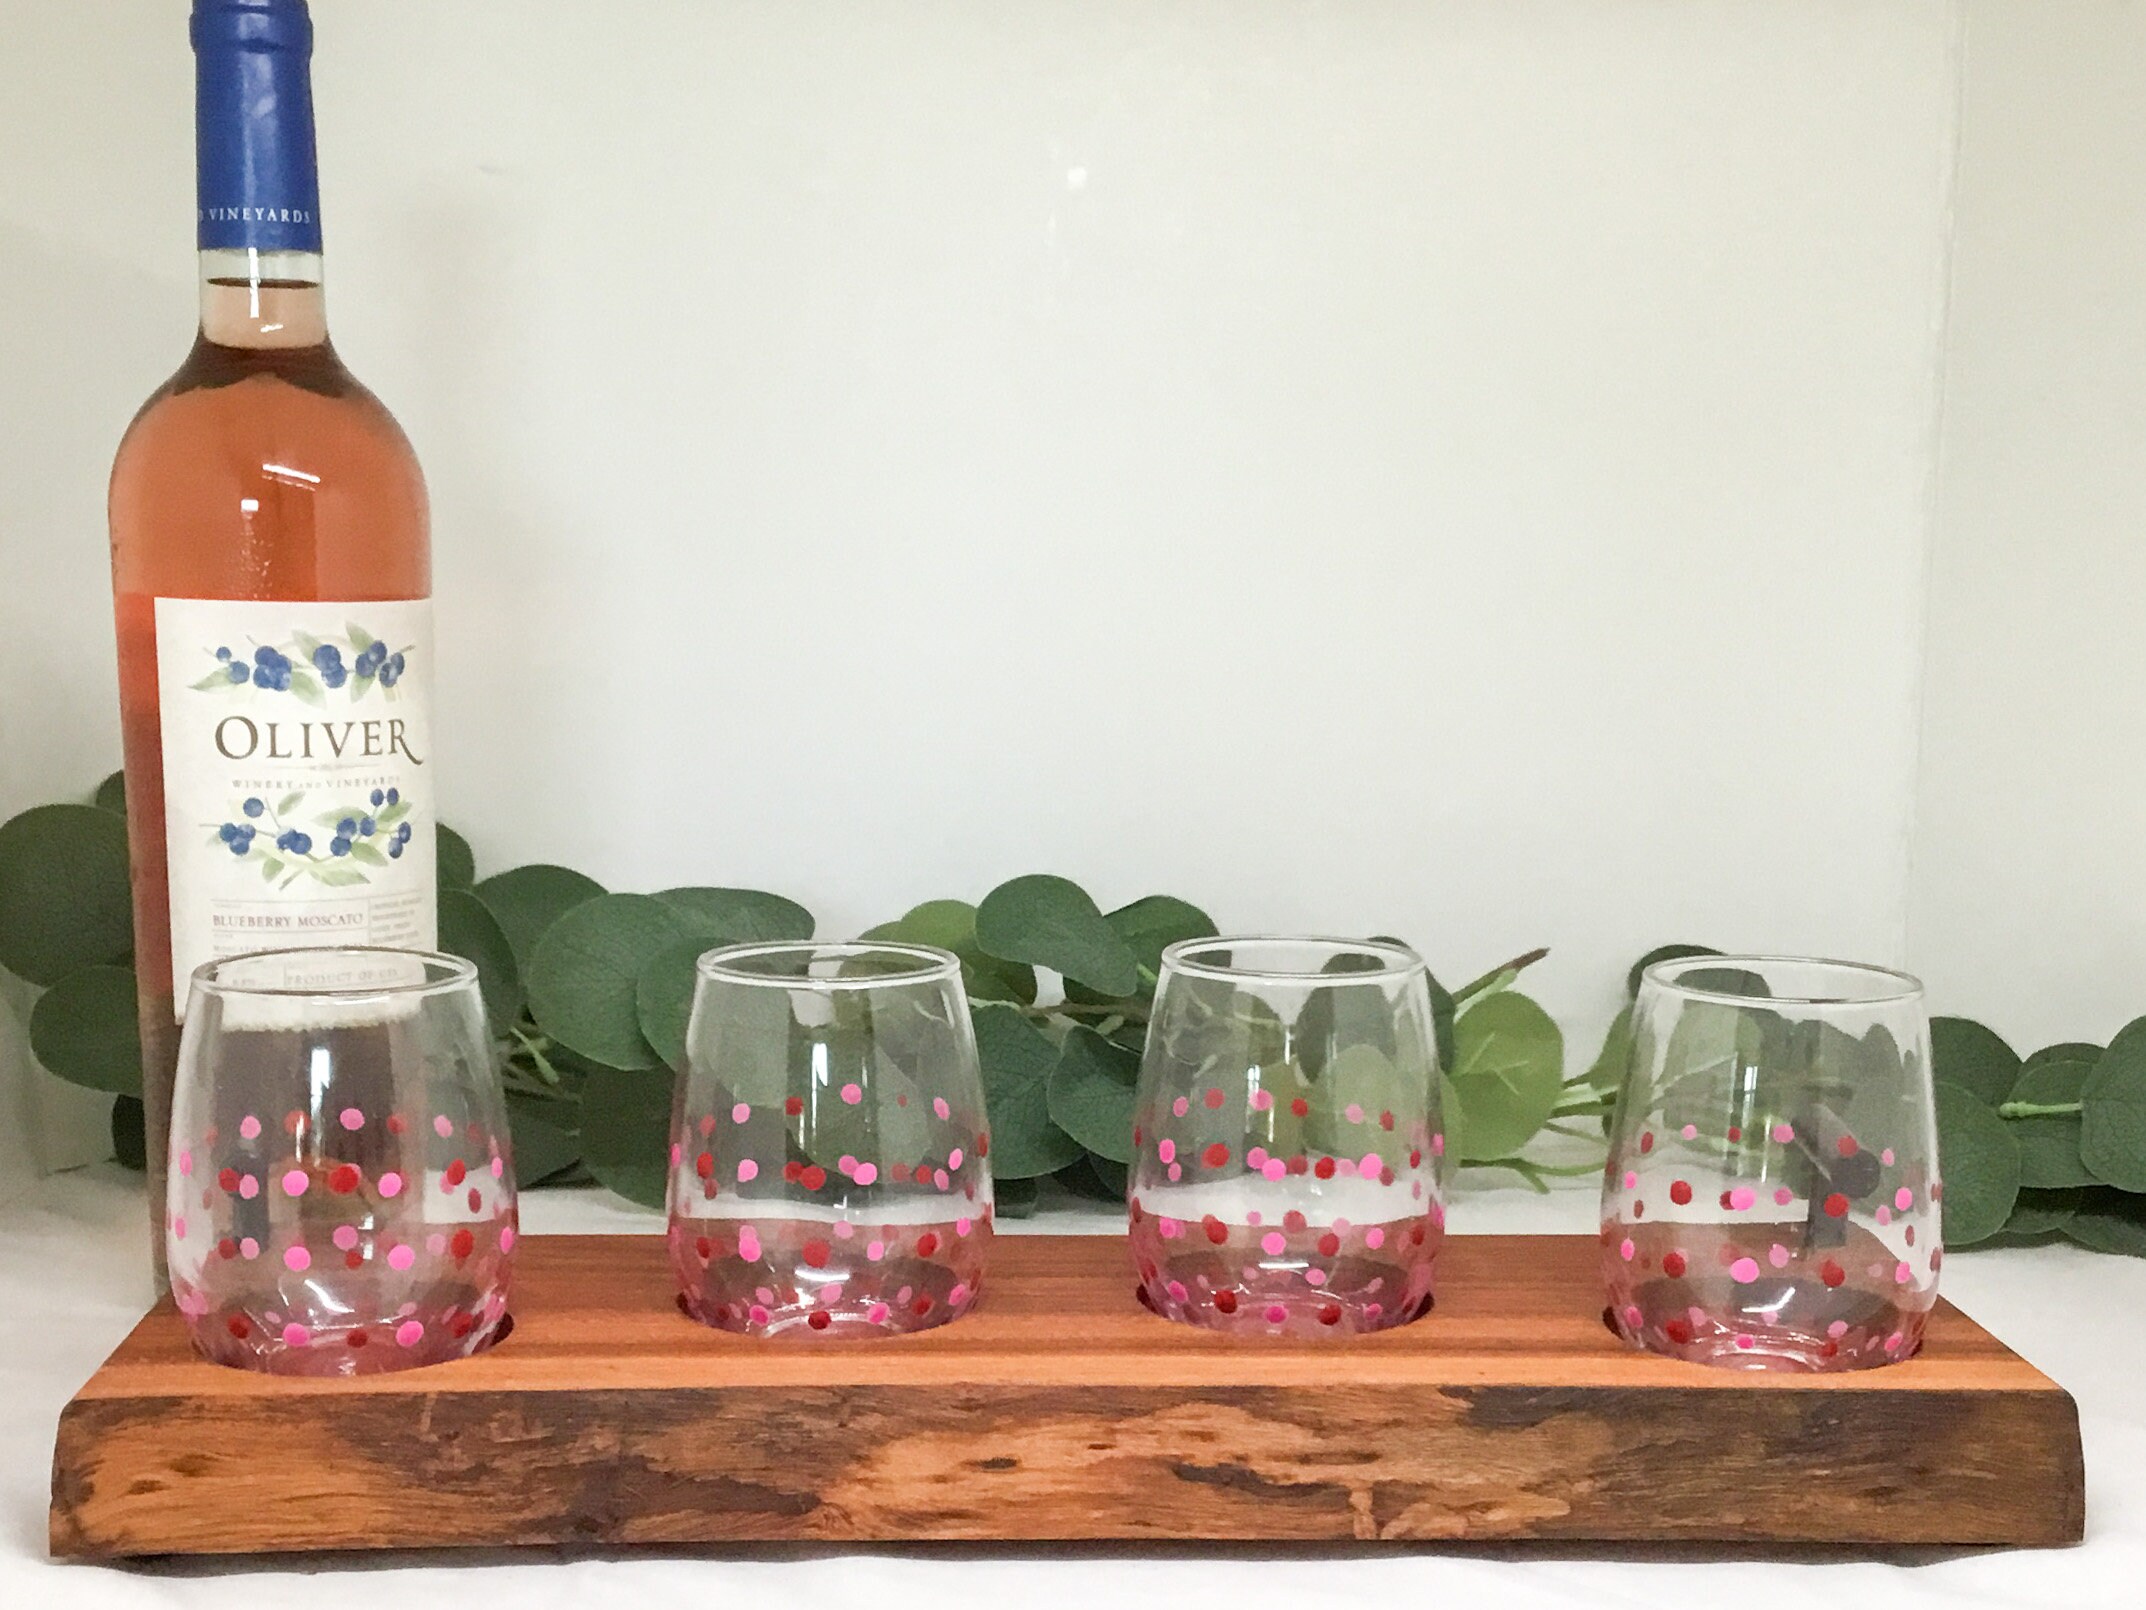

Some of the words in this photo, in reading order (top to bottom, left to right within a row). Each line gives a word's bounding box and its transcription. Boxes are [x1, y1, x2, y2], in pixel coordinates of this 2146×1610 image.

[208, 207, 311, 224] VINEYARDS
[214, 715, 424, 766] OLIVER
[232, 779, 294, 789] WINERY
[325, 776, 400, 788] VINEYARDS
[212, 914, 292, 928] BLUEBERRY
[297, 912, 363, 928] MOSCATO
